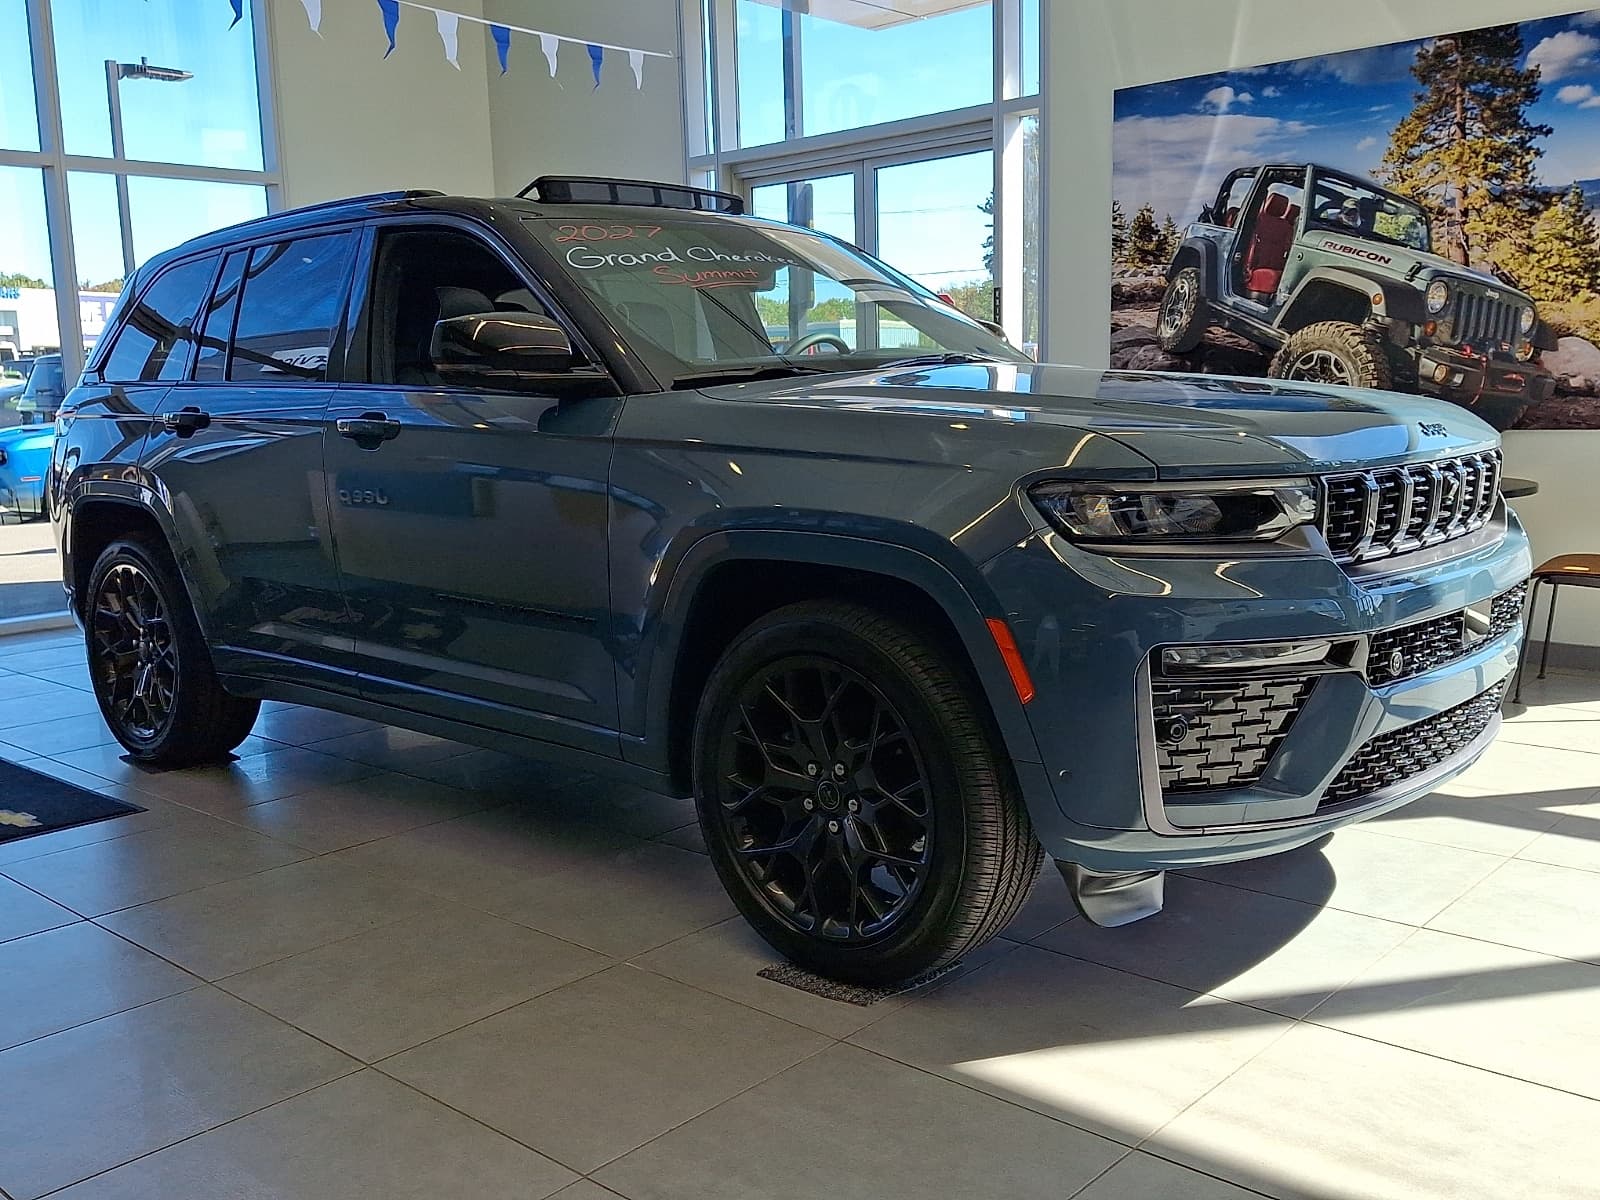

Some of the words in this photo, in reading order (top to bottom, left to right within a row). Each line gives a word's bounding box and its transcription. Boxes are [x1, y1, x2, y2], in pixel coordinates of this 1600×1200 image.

[555, 225, 662, 242] 2027
[566, 246, 684, 269] Grand
[687, 246, 800, 266] Cherokee
[1323, 241, 1392, 264] RUBICON
[653, 265, 759, 283] Summit
[1417, 421, 1448, 438] Jeep
